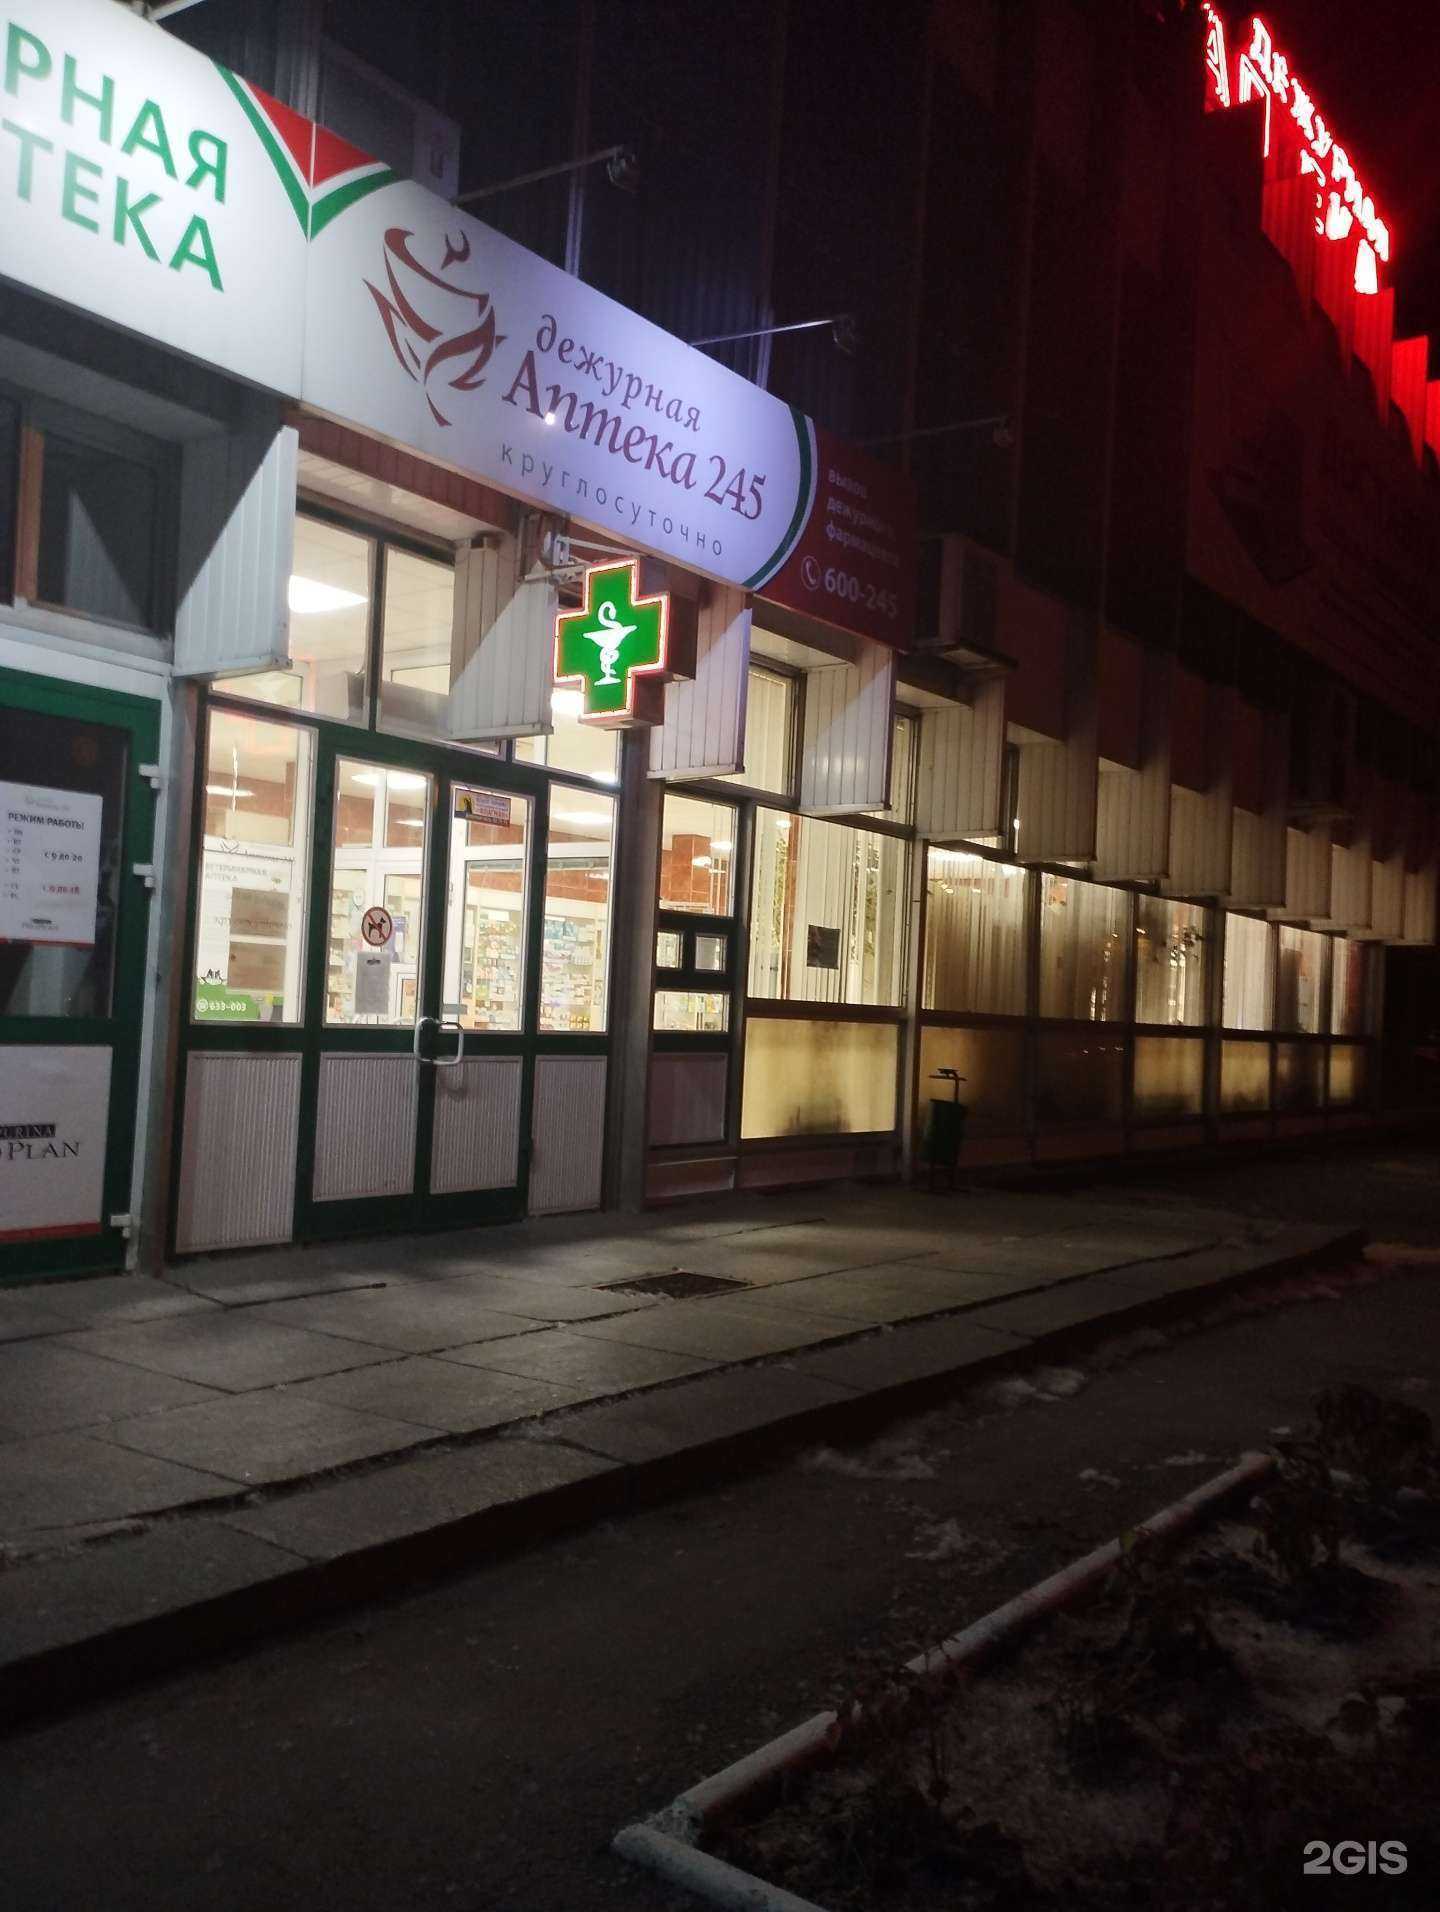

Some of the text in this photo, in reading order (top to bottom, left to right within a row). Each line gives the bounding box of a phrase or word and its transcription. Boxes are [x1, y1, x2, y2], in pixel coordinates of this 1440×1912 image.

[4, 20, 228, 206] РНАЯ
[2, 117, 225, 294] ТЕКА
[536, 314, 701, 432] дежурная
[502, 350, 768, 520] Аптека 245
[501, 443, 724, 556] круглосуточно
[824, 568, 898, 621] 600-245
[8, 812, 85, 831] РЕЖИМ РАБОТЫ
